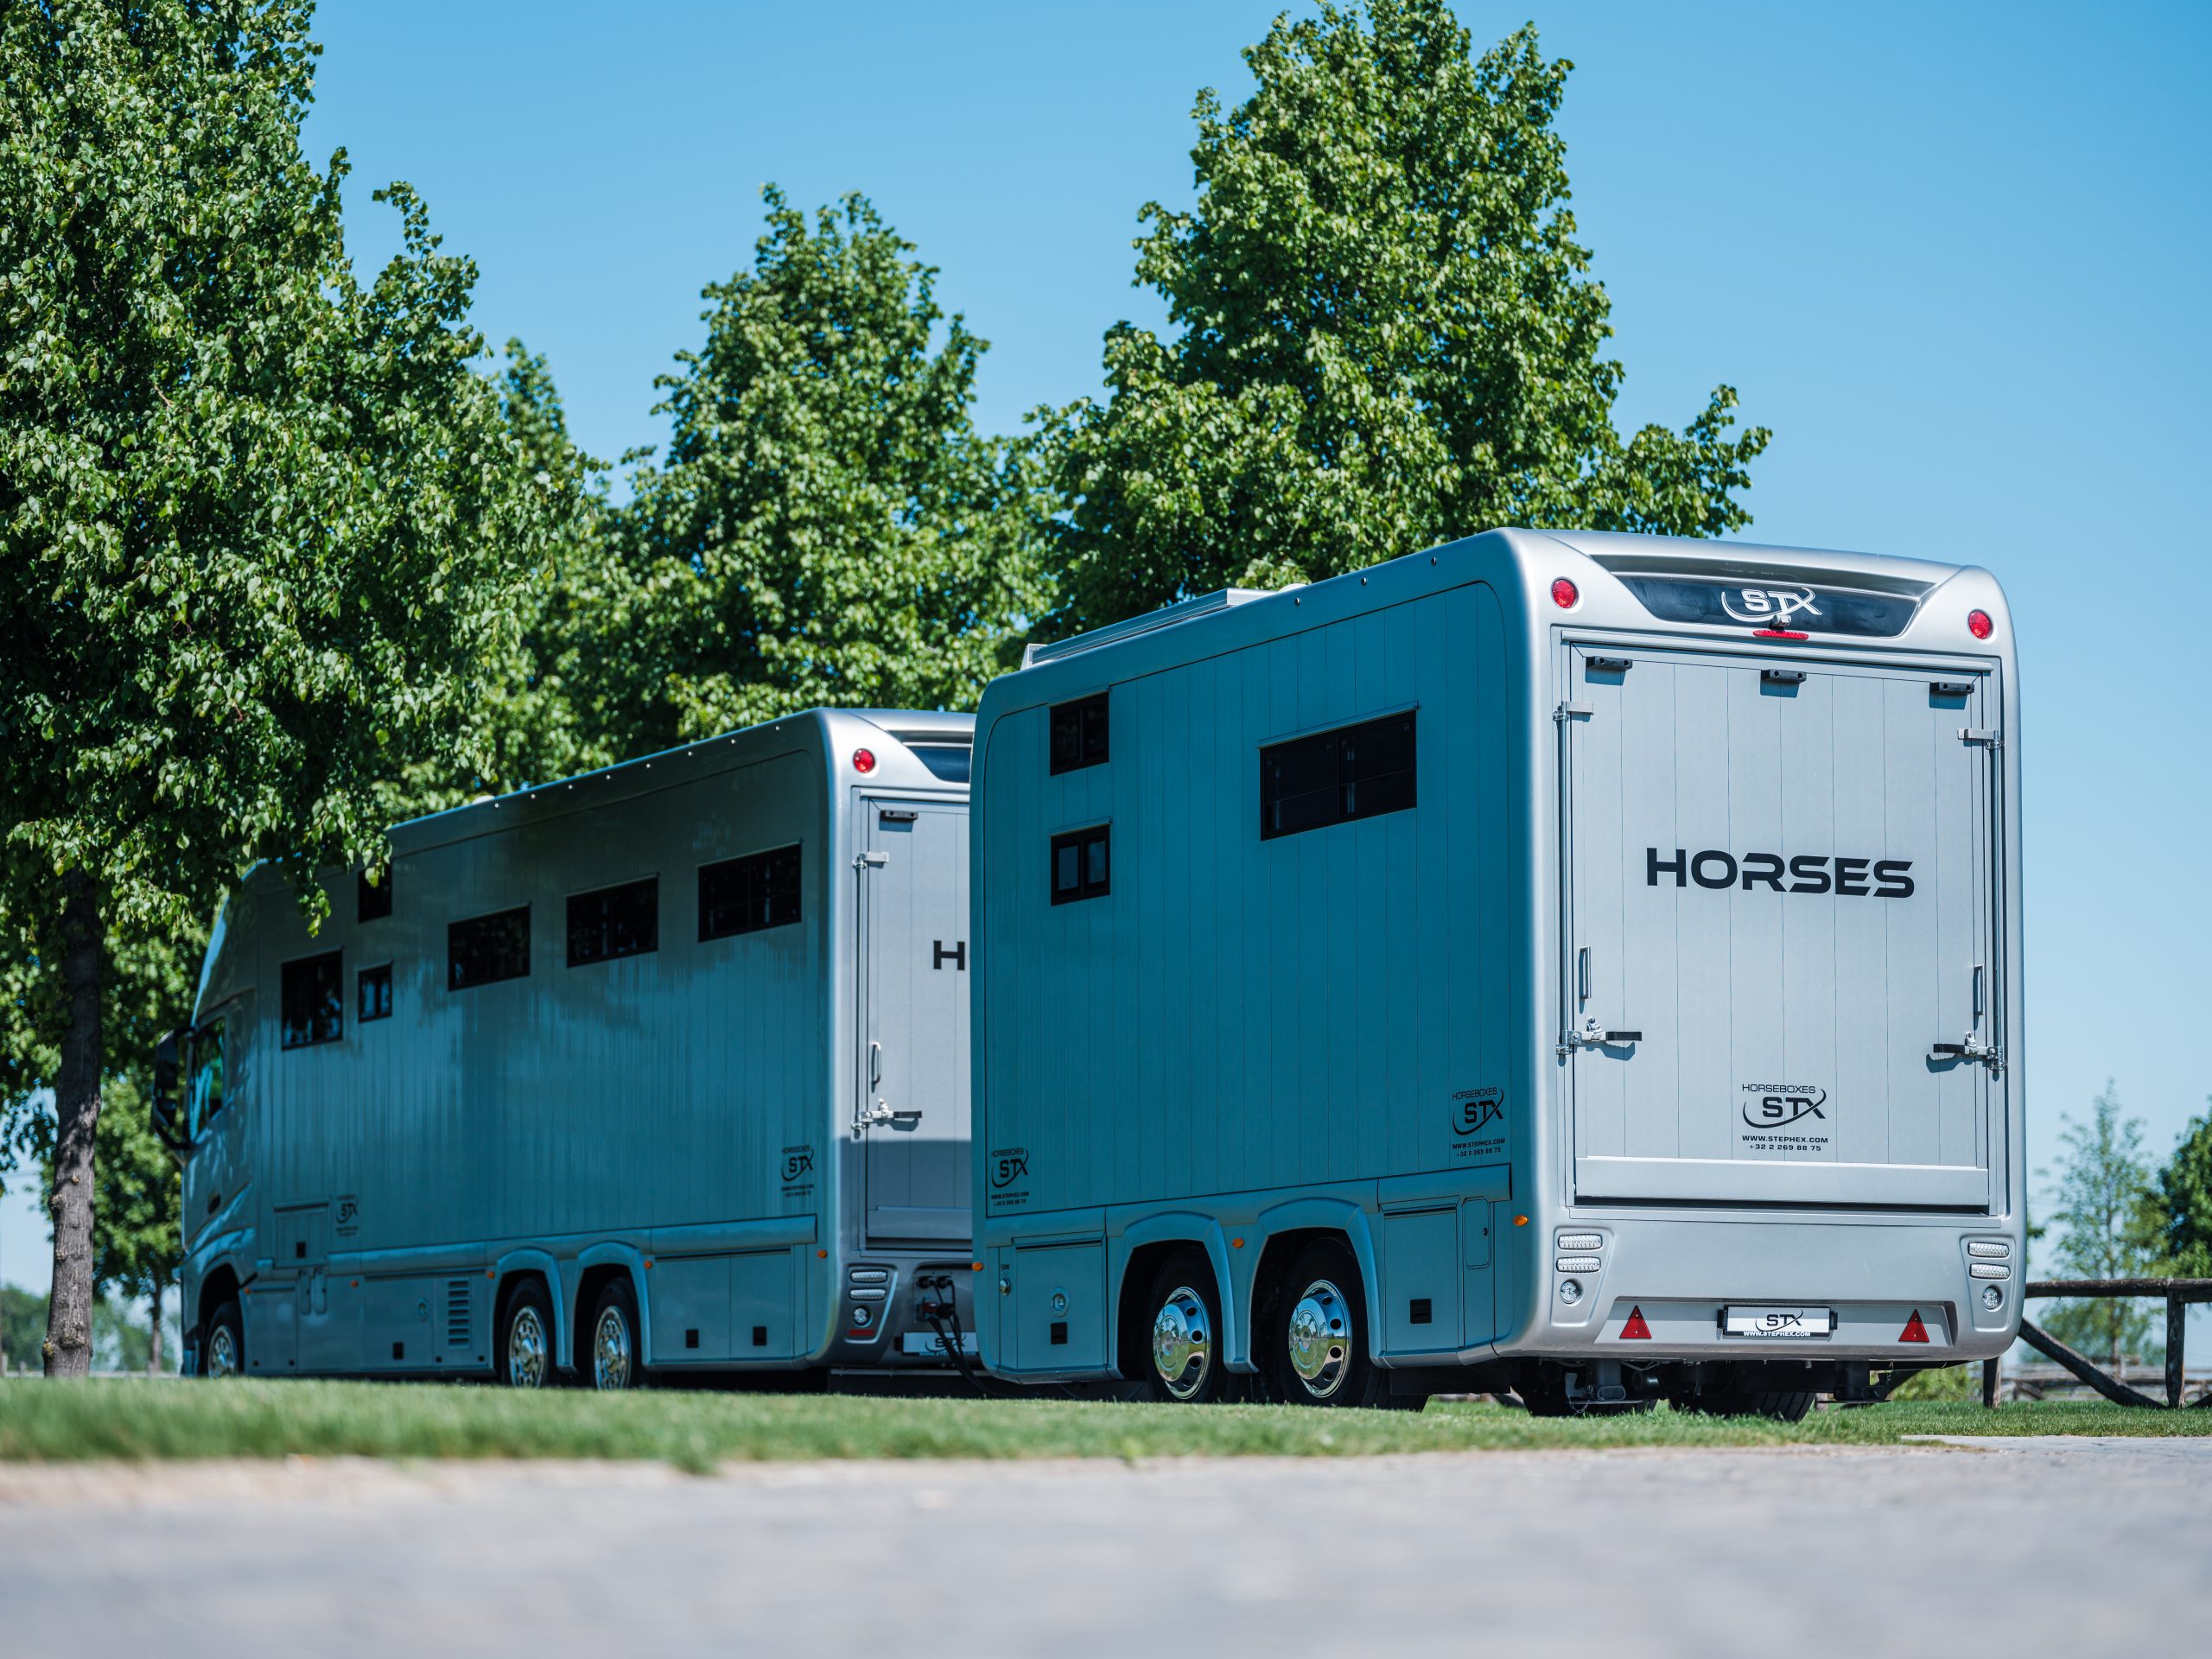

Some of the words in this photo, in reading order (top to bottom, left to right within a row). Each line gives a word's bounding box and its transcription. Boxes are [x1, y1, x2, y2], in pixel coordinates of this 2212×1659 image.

[1740, 588, 1823, 616] STX
[1646, 847, 1915, 898] HORSES
[1452, 1087, 1497, 1101] HORSEBOXES
[1742, 1084, 1816, 1094] HORSEBOXES
[1464, 1089, 1504, 1124] STX
[1762, 1089, 1827, 1119] STX
[1452, 1138, 1506, 1150] WWW.STEPHEX.COM
[789, 1147, 815, 1173] STX
[1000, 1148, 1029, 1178] STX
[1766, 1309, 1804, 1326] STX
